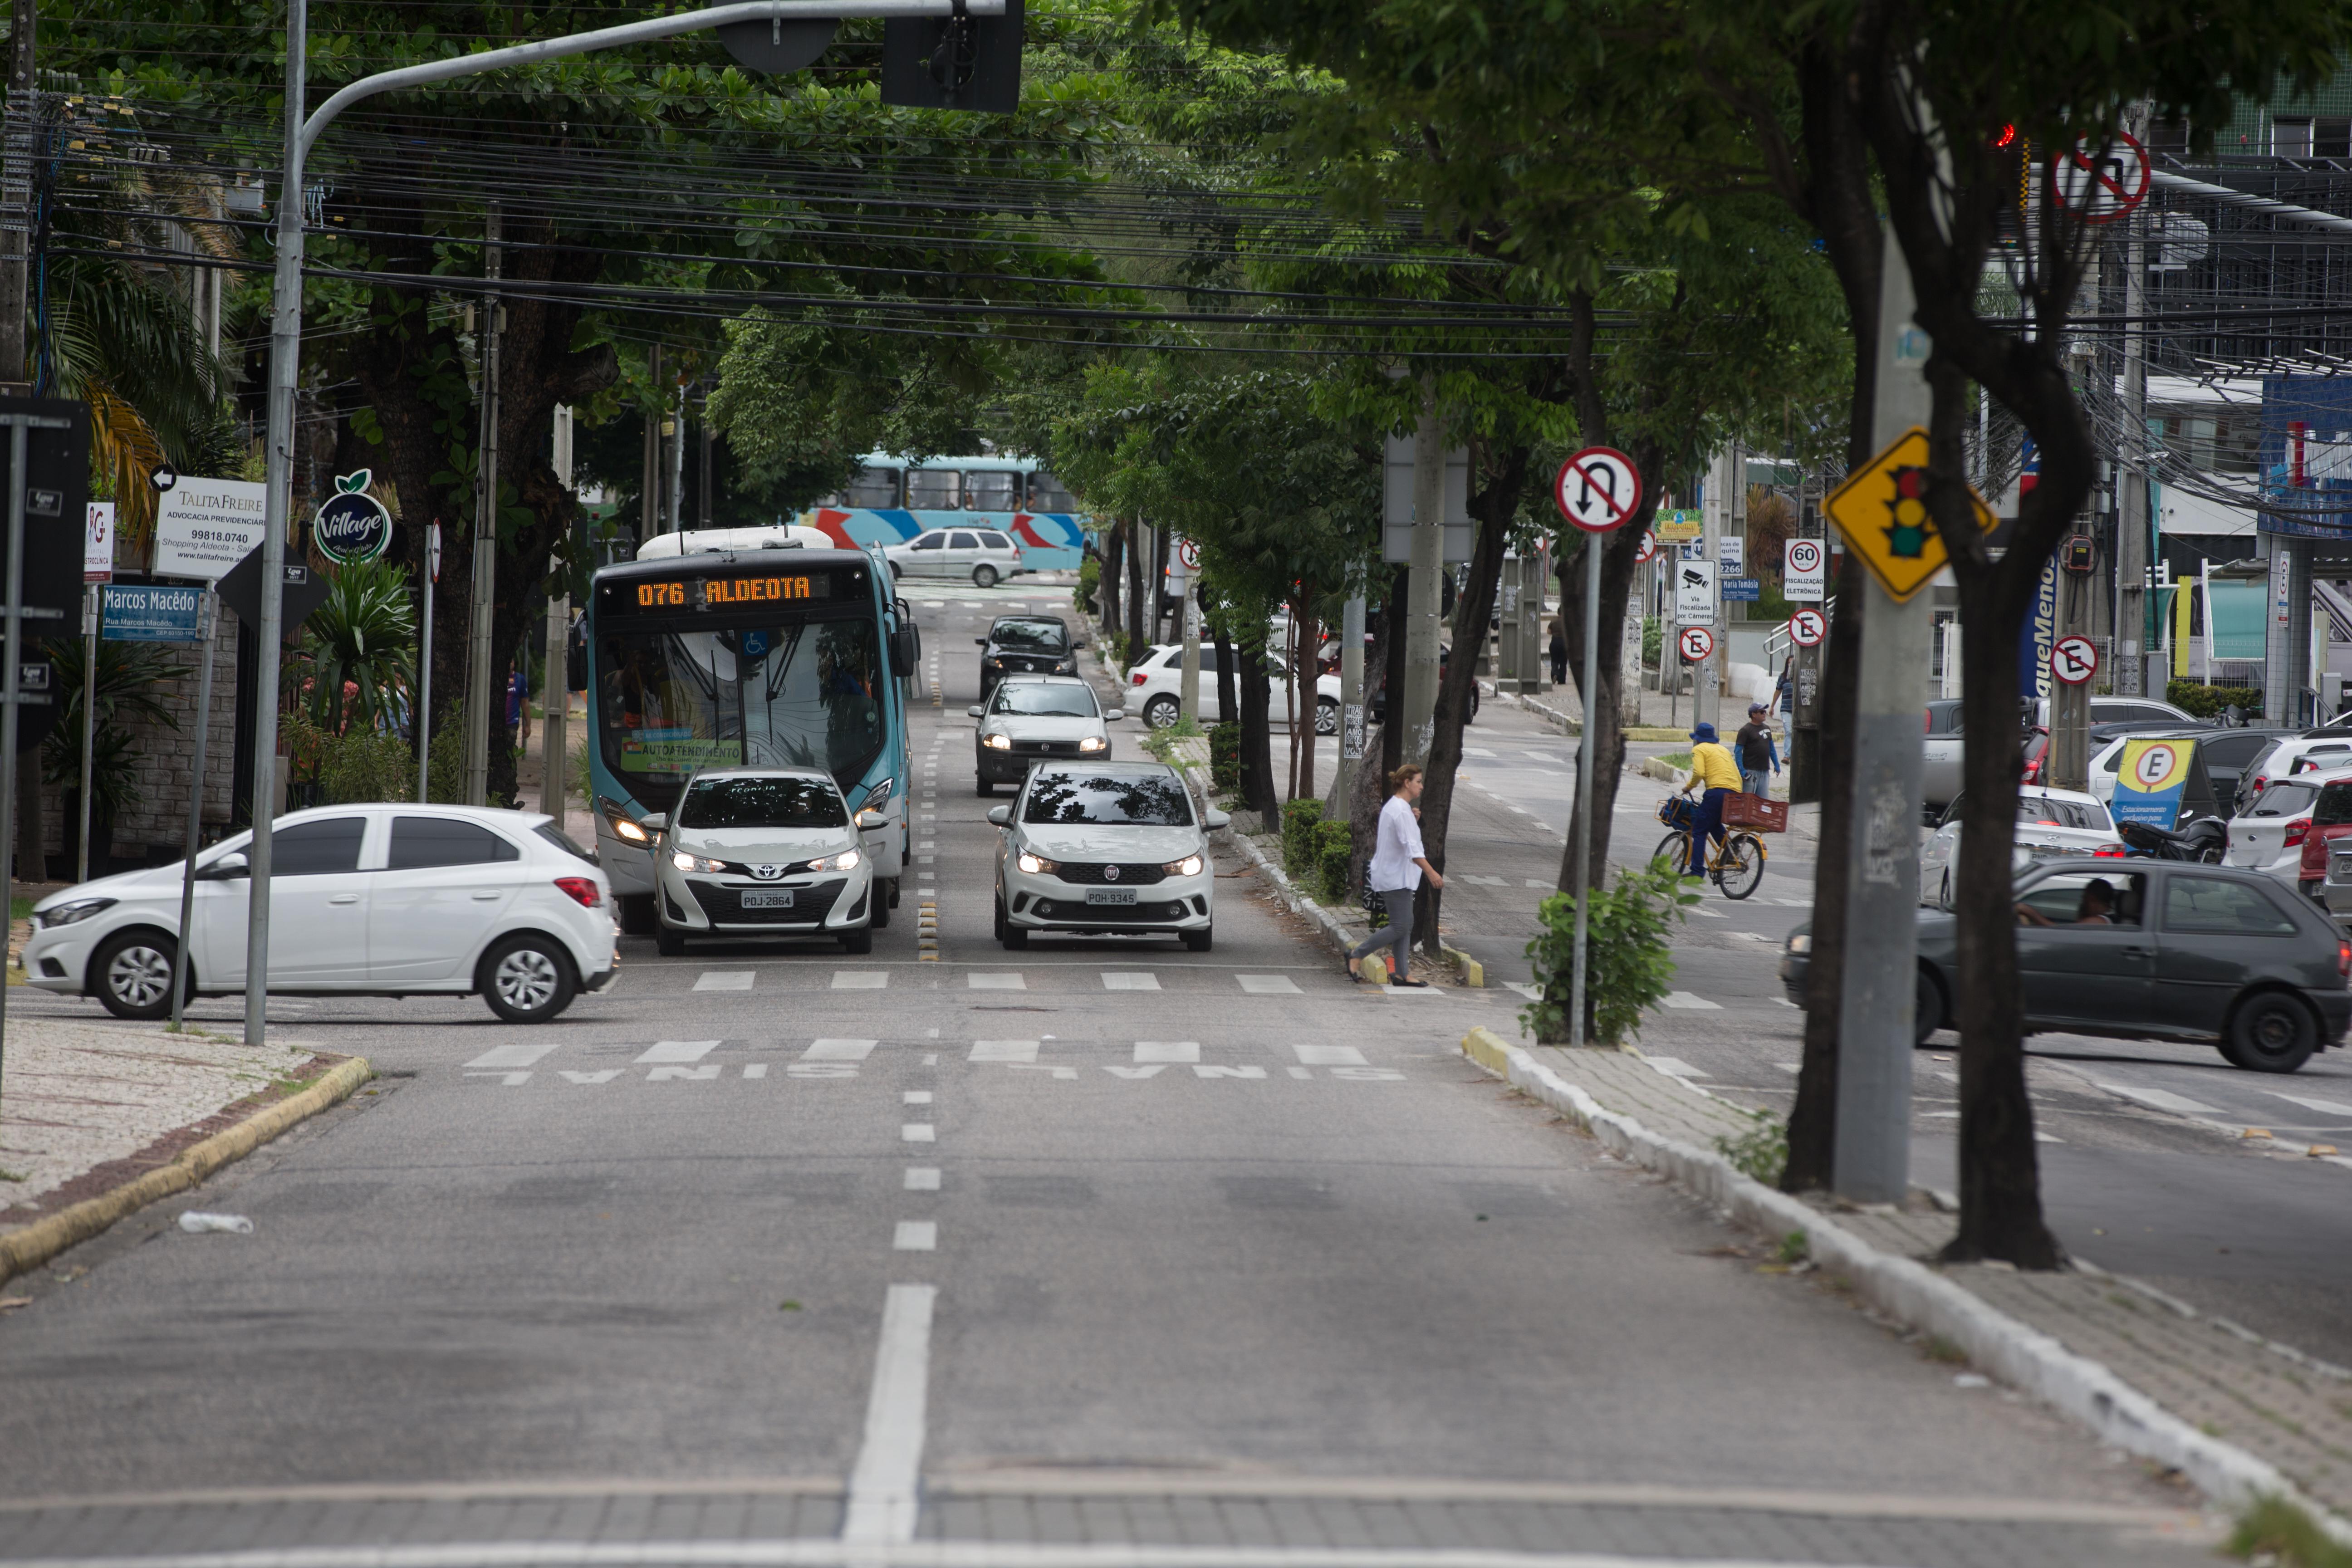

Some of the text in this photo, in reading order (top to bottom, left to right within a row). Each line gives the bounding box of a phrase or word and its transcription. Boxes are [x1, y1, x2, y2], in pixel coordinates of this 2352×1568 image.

[167, 511, 265, 526] ADVOCACIA PREVIDENCIÁRI
[319, 511, 382, 541] Village
[191, 529, 248, 544] 99818.0740
[162, 538, 198, 550] Shopping
[200, 541, 229, 551] Aldeota
[354, 543, 372, 554] Glato
[84, 554, 108, 565] STROCLÍNICA
[1794, 548, 1815, 561] 60
[638, 577, 809, 605] 076 ALDEOTA
[1724, 579, 1758, 589] Maria Tomásia
[105, 589, 194, 611] Marcos Macêdo
[147, 619, 172, 627] Macêdo
[1801, 617, 1814, 637] E
[1690, 635, 1702, 653] E
[2065, 645, 2085, 673] E
[653, 730, 691, 739] CONDICIONADO
[642, 744, 740, 759] AUTOATENDIMENTO
[2147, 754, 2165, 777] E
